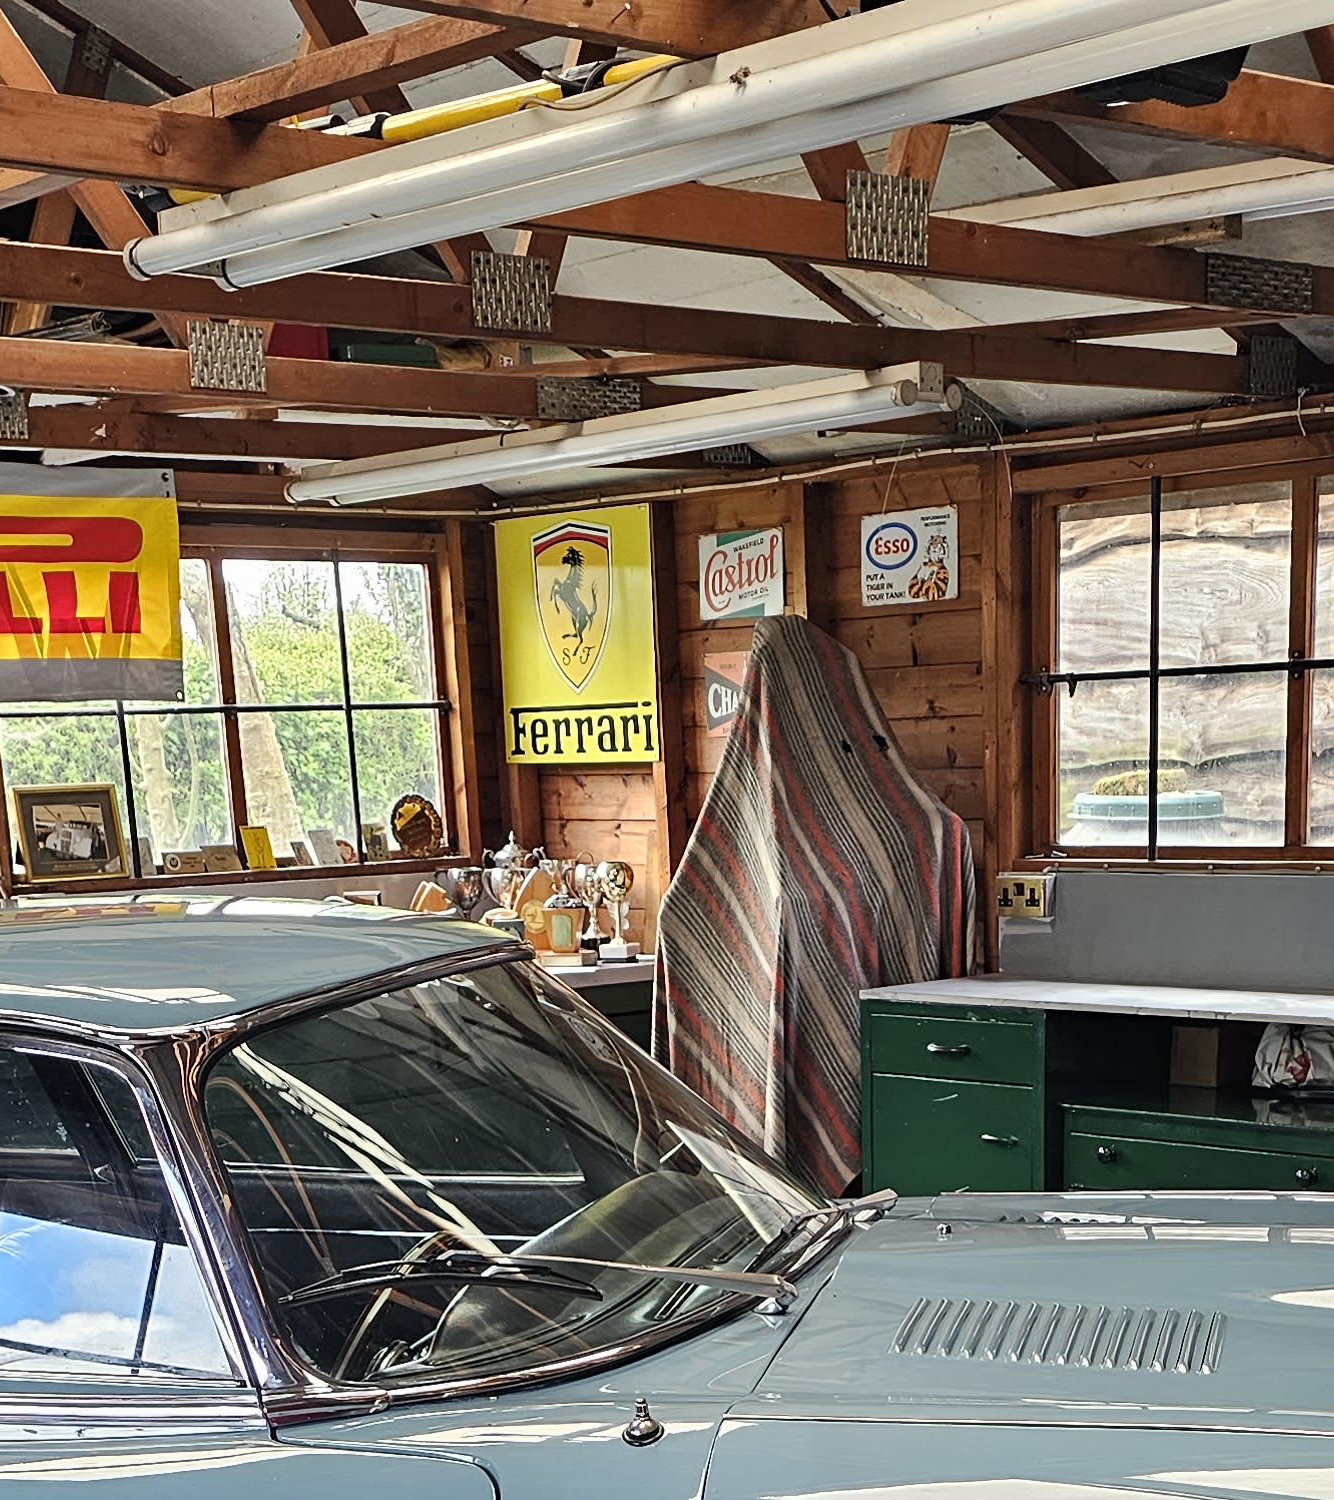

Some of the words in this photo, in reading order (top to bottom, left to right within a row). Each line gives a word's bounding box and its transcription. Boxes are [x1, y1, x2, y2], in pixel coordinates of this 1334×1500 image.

[733, 537, 764, 552] WAKEFIELD
[704, 534, 779, 612] Castrol
[866, 574, 879, 582] PUT
[738, 589, 758, 600] MOTOR
[759, 586, 769, 595] OIL
[866, 582, 885, 592] TIGER
[886, 582, 894, 590] IN
[866, 592, 885, 601] YOUR
[562, 648, 572, 665] S
[509, 701, 655, 756] Ferrari
